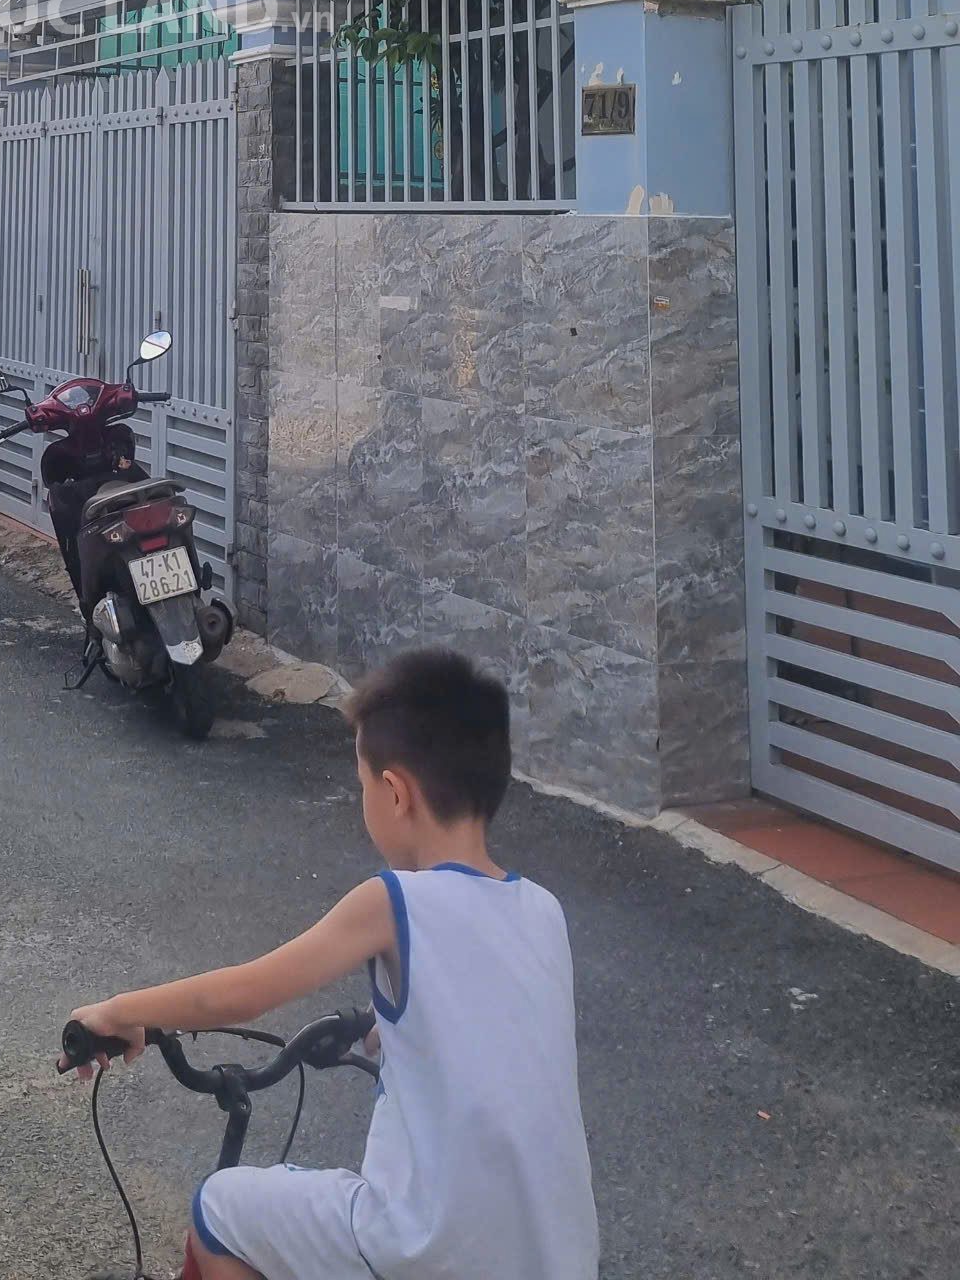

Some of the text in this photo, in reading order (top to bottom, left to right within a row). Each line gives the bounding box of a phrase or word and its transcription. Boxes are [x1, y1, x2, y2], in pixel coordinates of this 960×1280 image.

[584, 89, 630, 124] 71/9
[140, 551, 181, 578] 47-K1
[139, 570, 193, 602] 286.21
